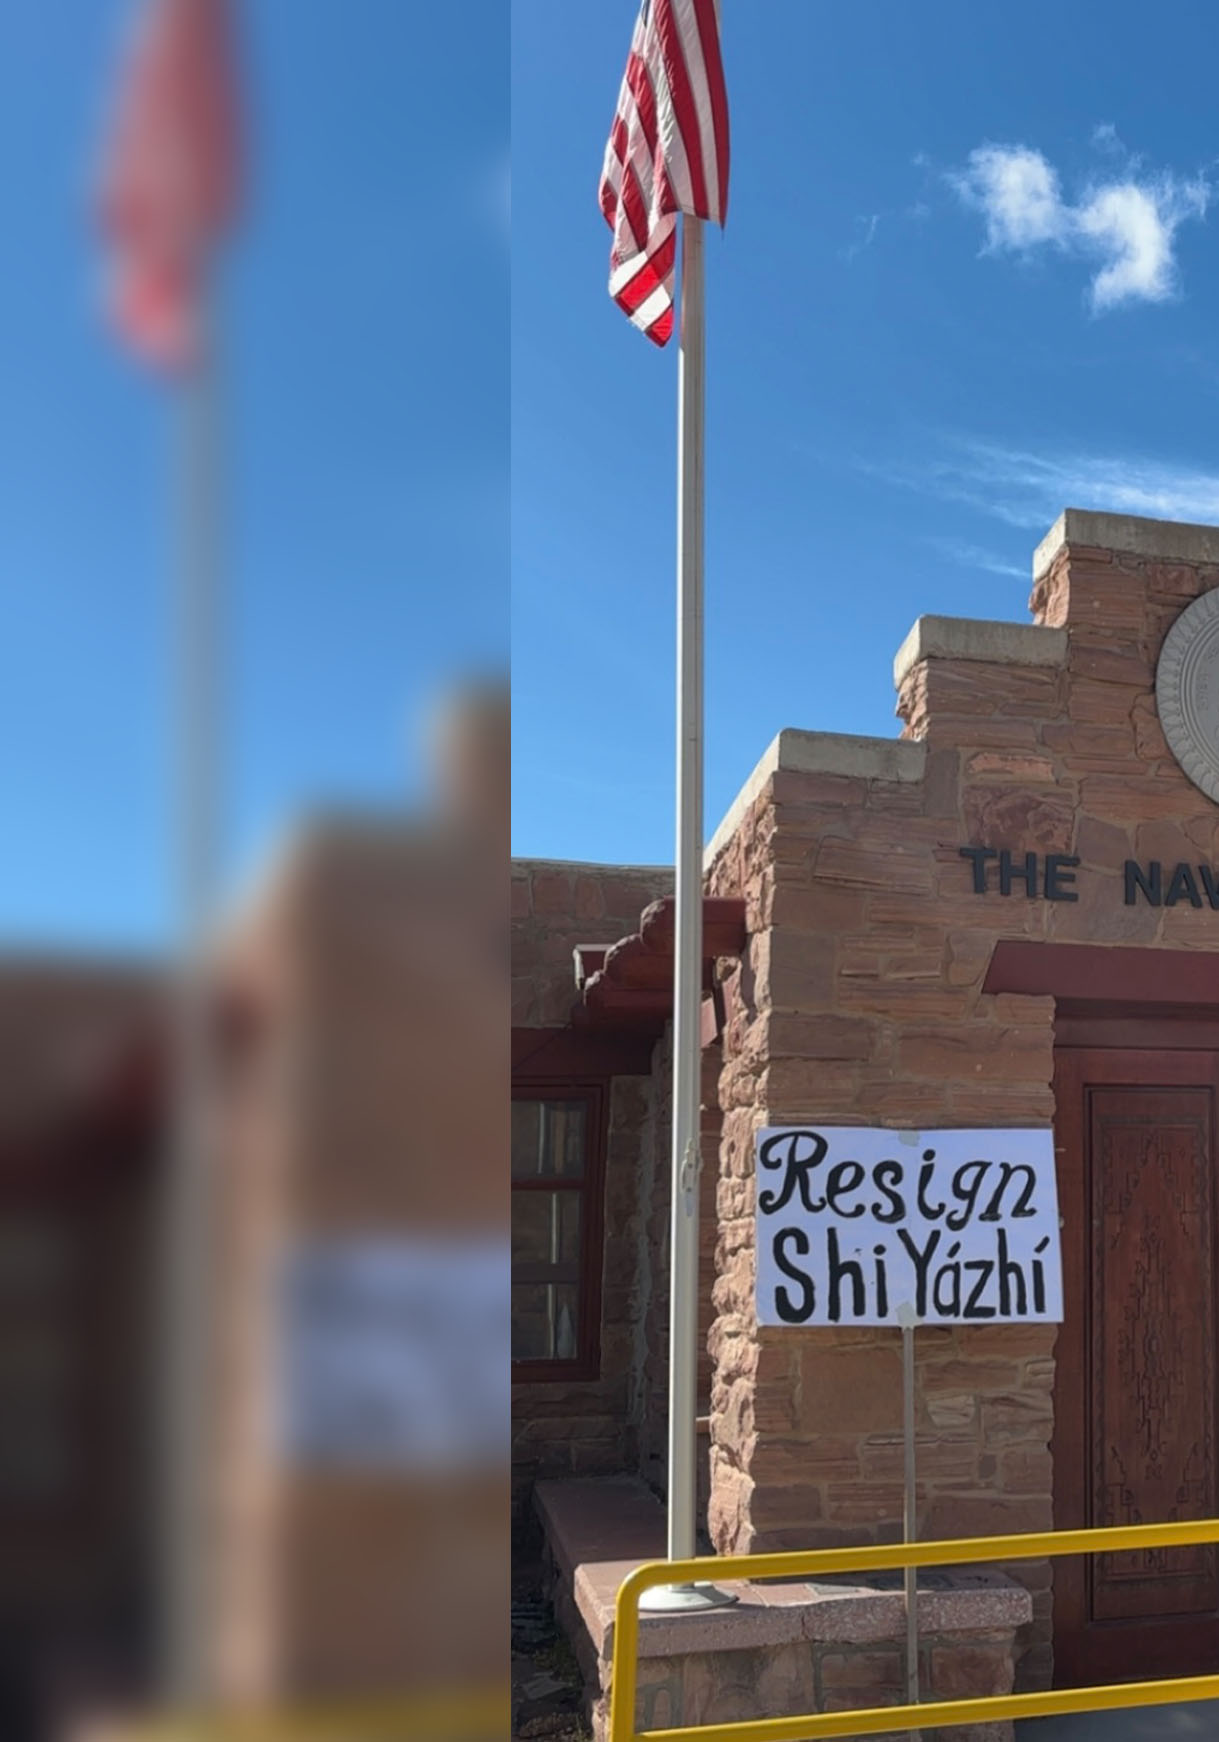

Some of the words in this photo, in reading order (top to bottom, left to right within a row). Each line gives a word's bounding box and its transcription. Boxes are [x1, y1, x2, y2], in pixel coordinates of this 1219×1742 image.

[960, 847, 1080, 902] THE
[758, 1131, 1037, 1231] Resign
[772, 1226, 888, 1324] Shi
[896, 1227, 1050, 1319] Yázhí
